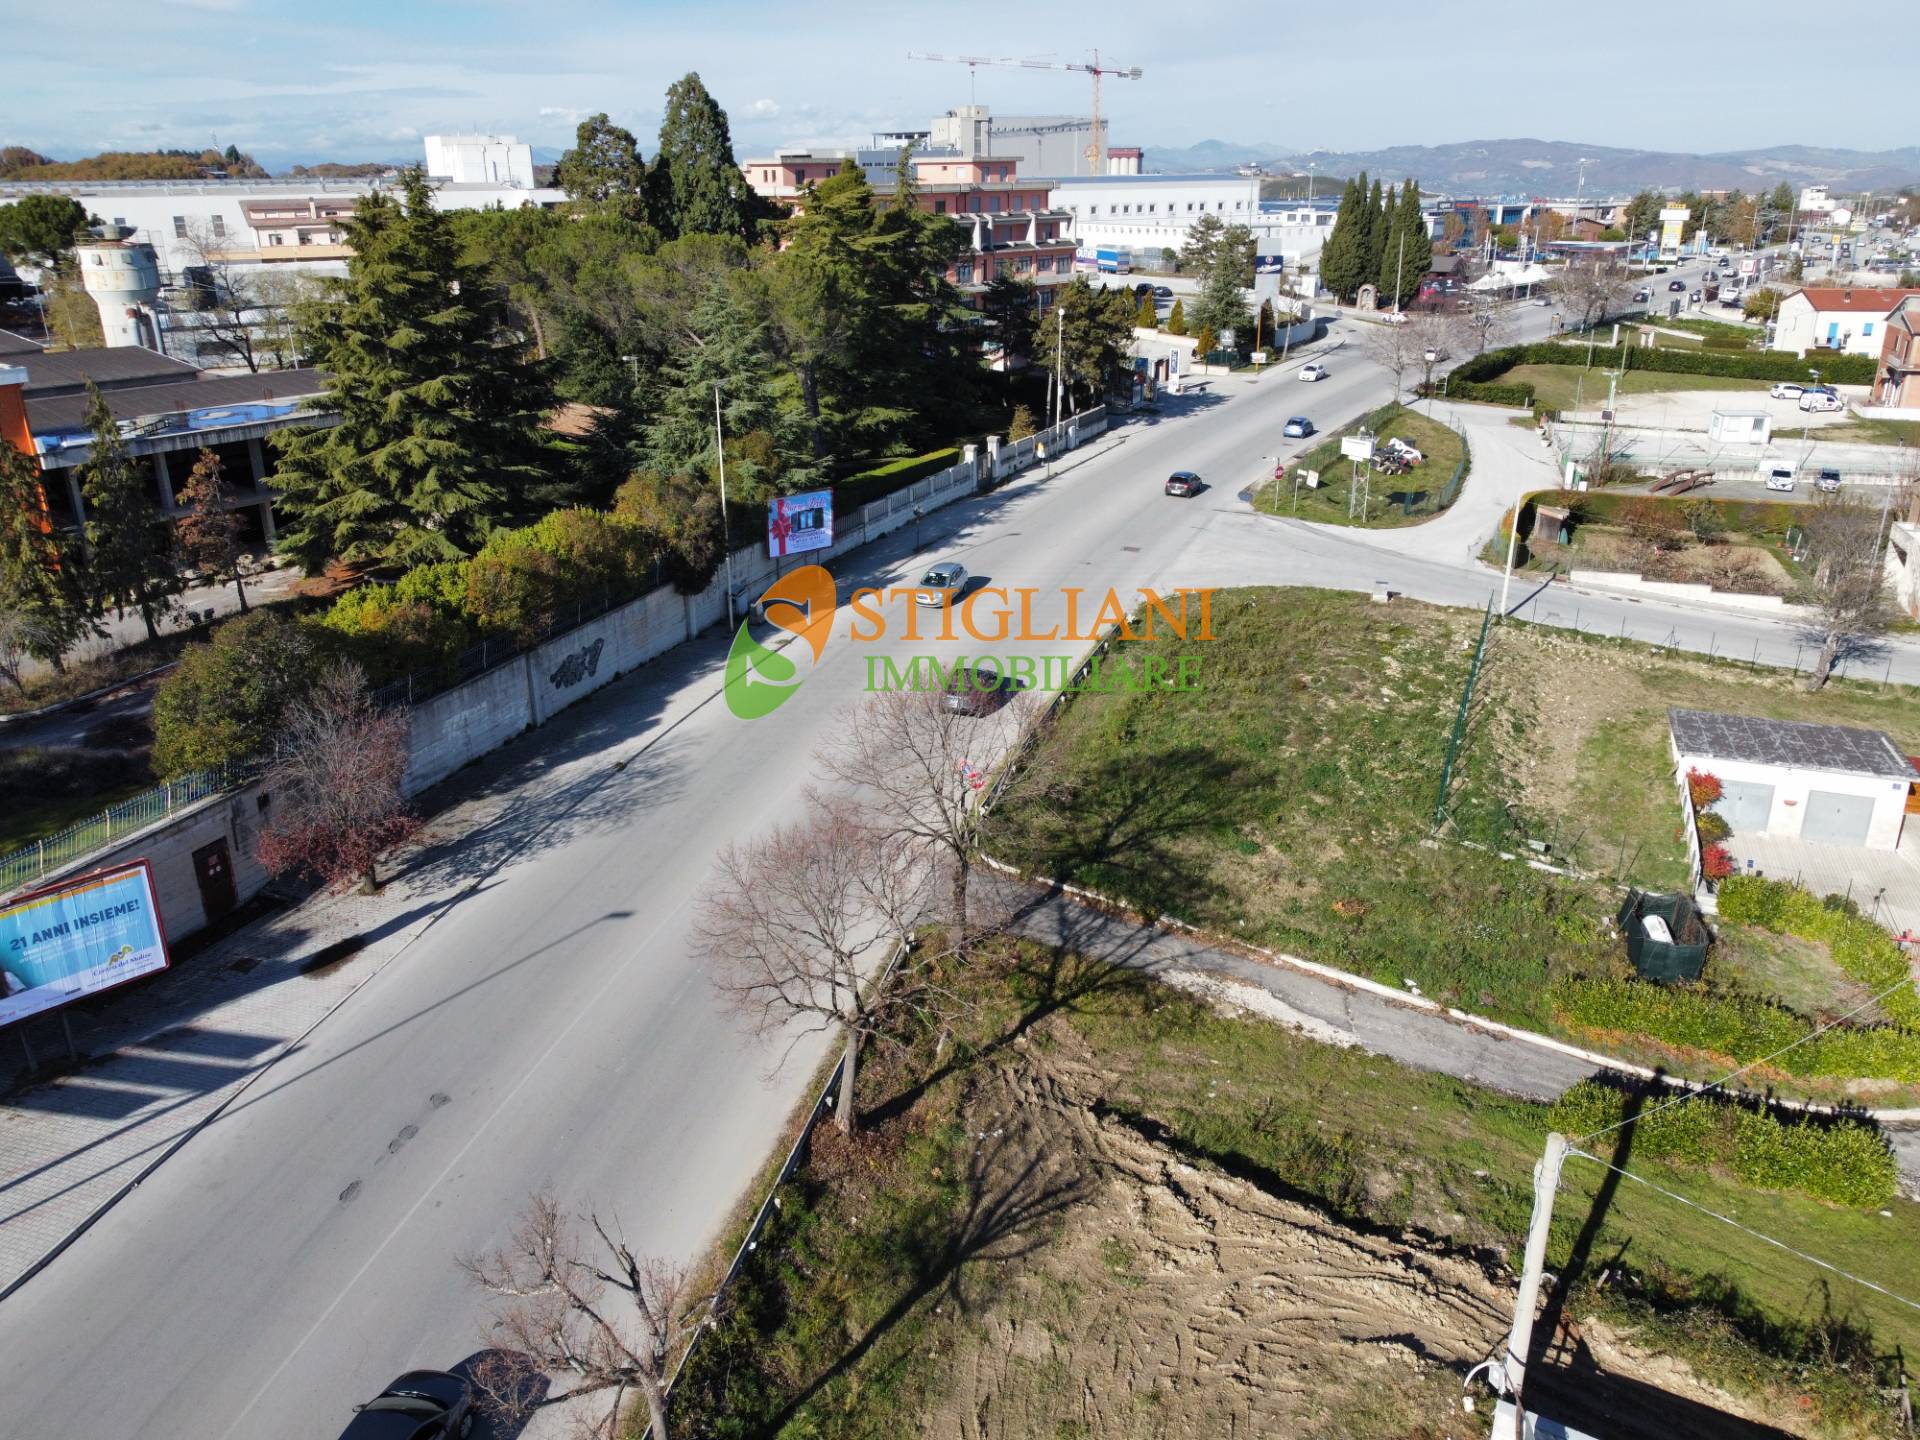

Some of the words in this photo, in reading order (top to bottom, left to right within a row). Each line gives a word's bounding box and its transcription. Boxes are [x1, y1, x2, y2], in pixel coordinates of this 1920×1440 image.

[10, 936, 27, 951] 21
[32, 922, 71, 944] ANNI
[74, 899, 140, 930] INSIEME!
